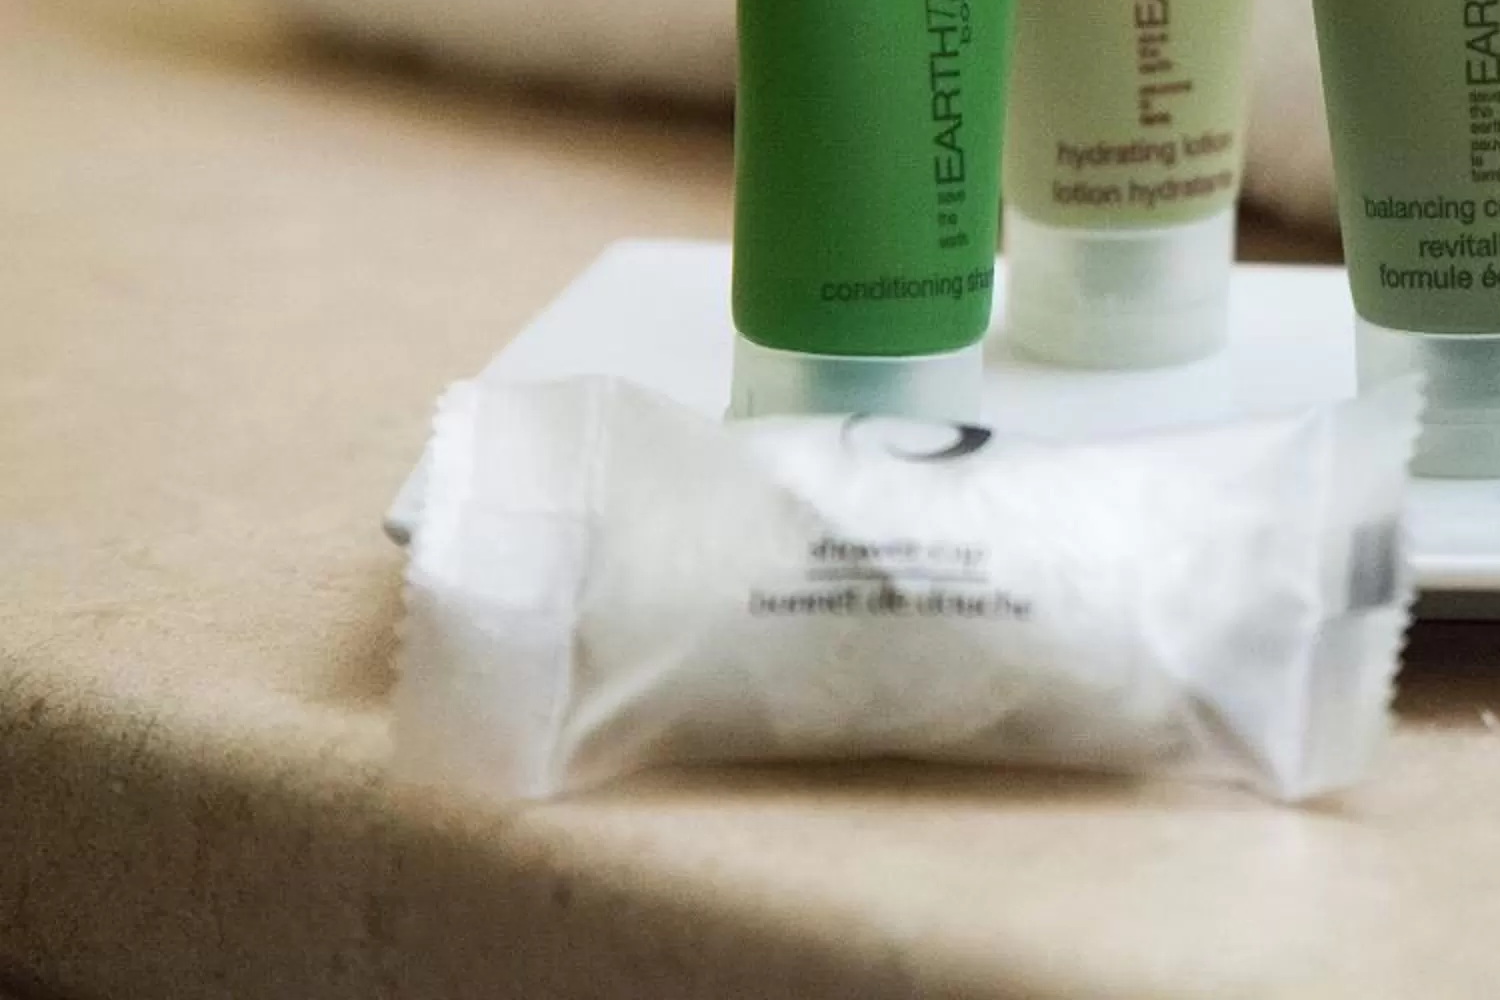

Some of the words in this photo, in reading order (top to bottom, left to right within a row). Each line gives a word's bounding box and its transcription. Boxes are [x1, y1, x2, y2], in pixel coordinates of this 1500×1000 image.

[1364, 196, 1475, 225] balancing
[821, 274, 964, 301] conditioning
[1379, 263, 1473, 290] formule
